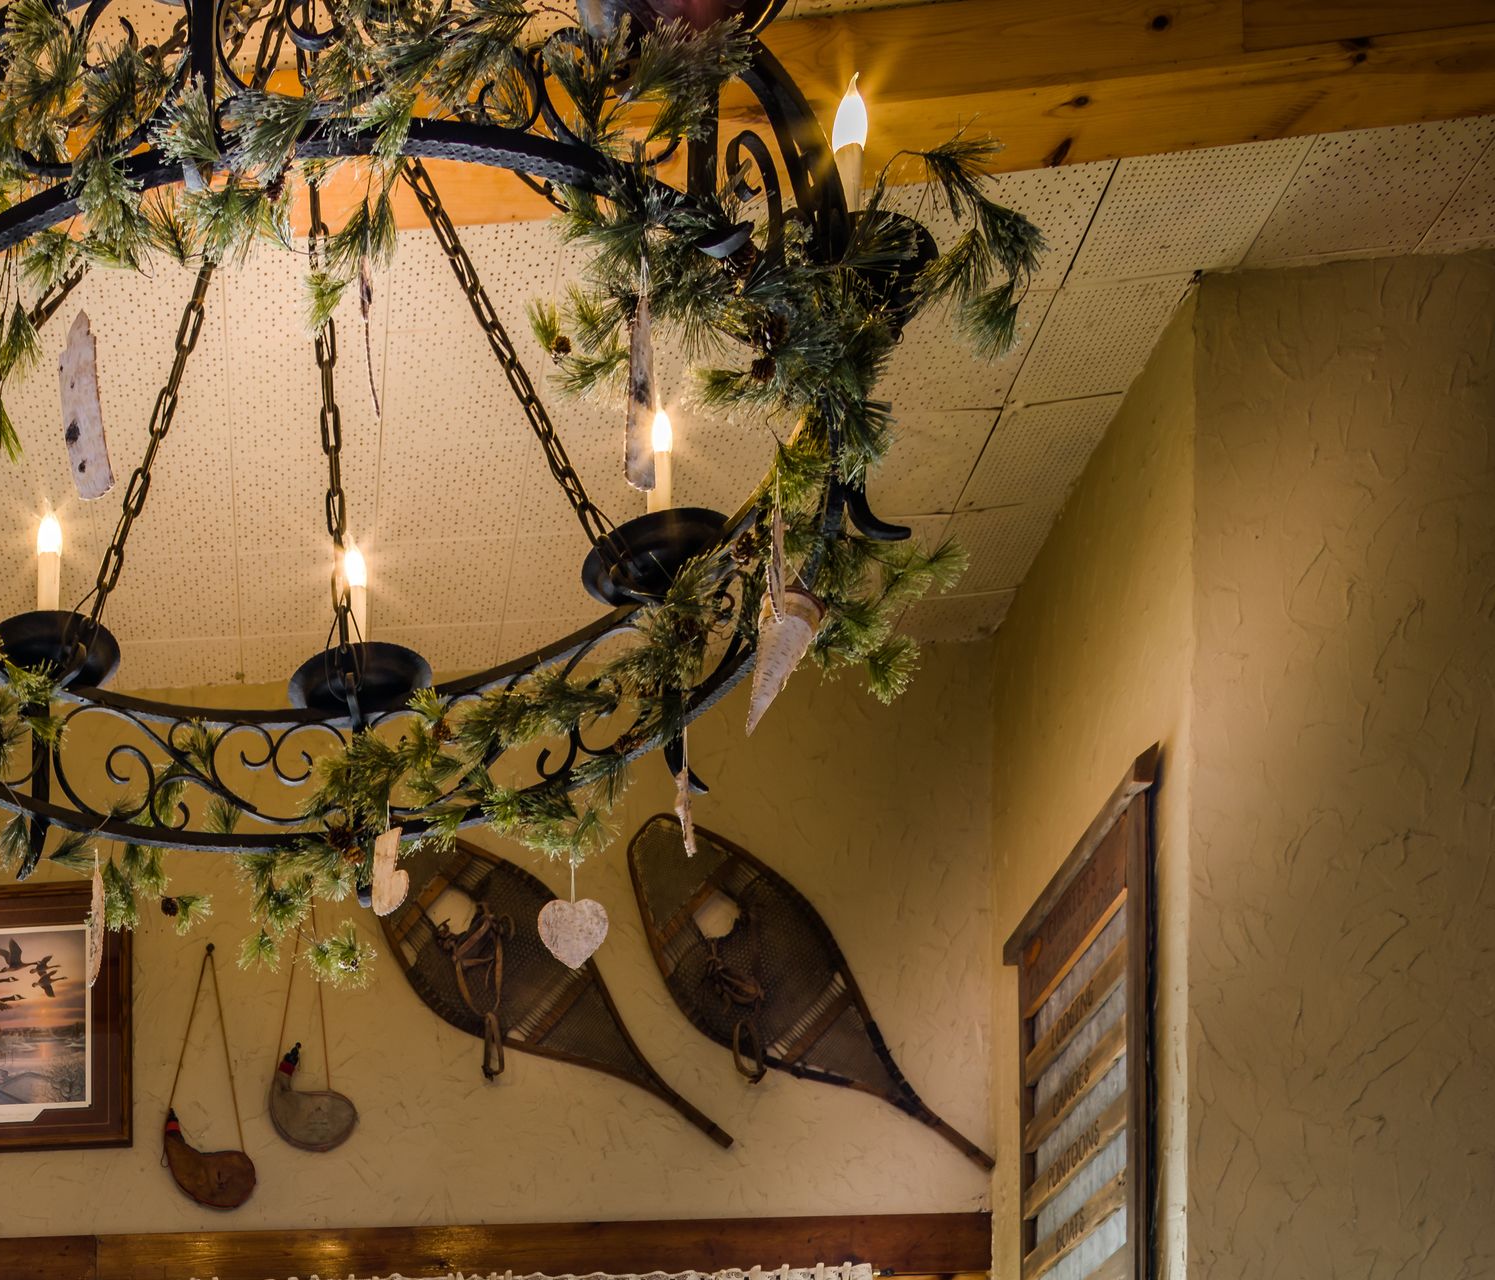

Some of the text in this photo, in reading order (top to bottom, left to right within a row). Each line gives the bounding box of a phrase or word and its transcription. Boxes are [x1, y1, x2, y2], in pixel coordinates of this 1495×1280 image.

[1051, 980, 1094, 1052] LODGING
[1053, 1057, 1090, 1117] CANOES
[1048, 1120, 1100, 1192] PONTOONS
[1056, 1207, 1084, 1254] BOATS
